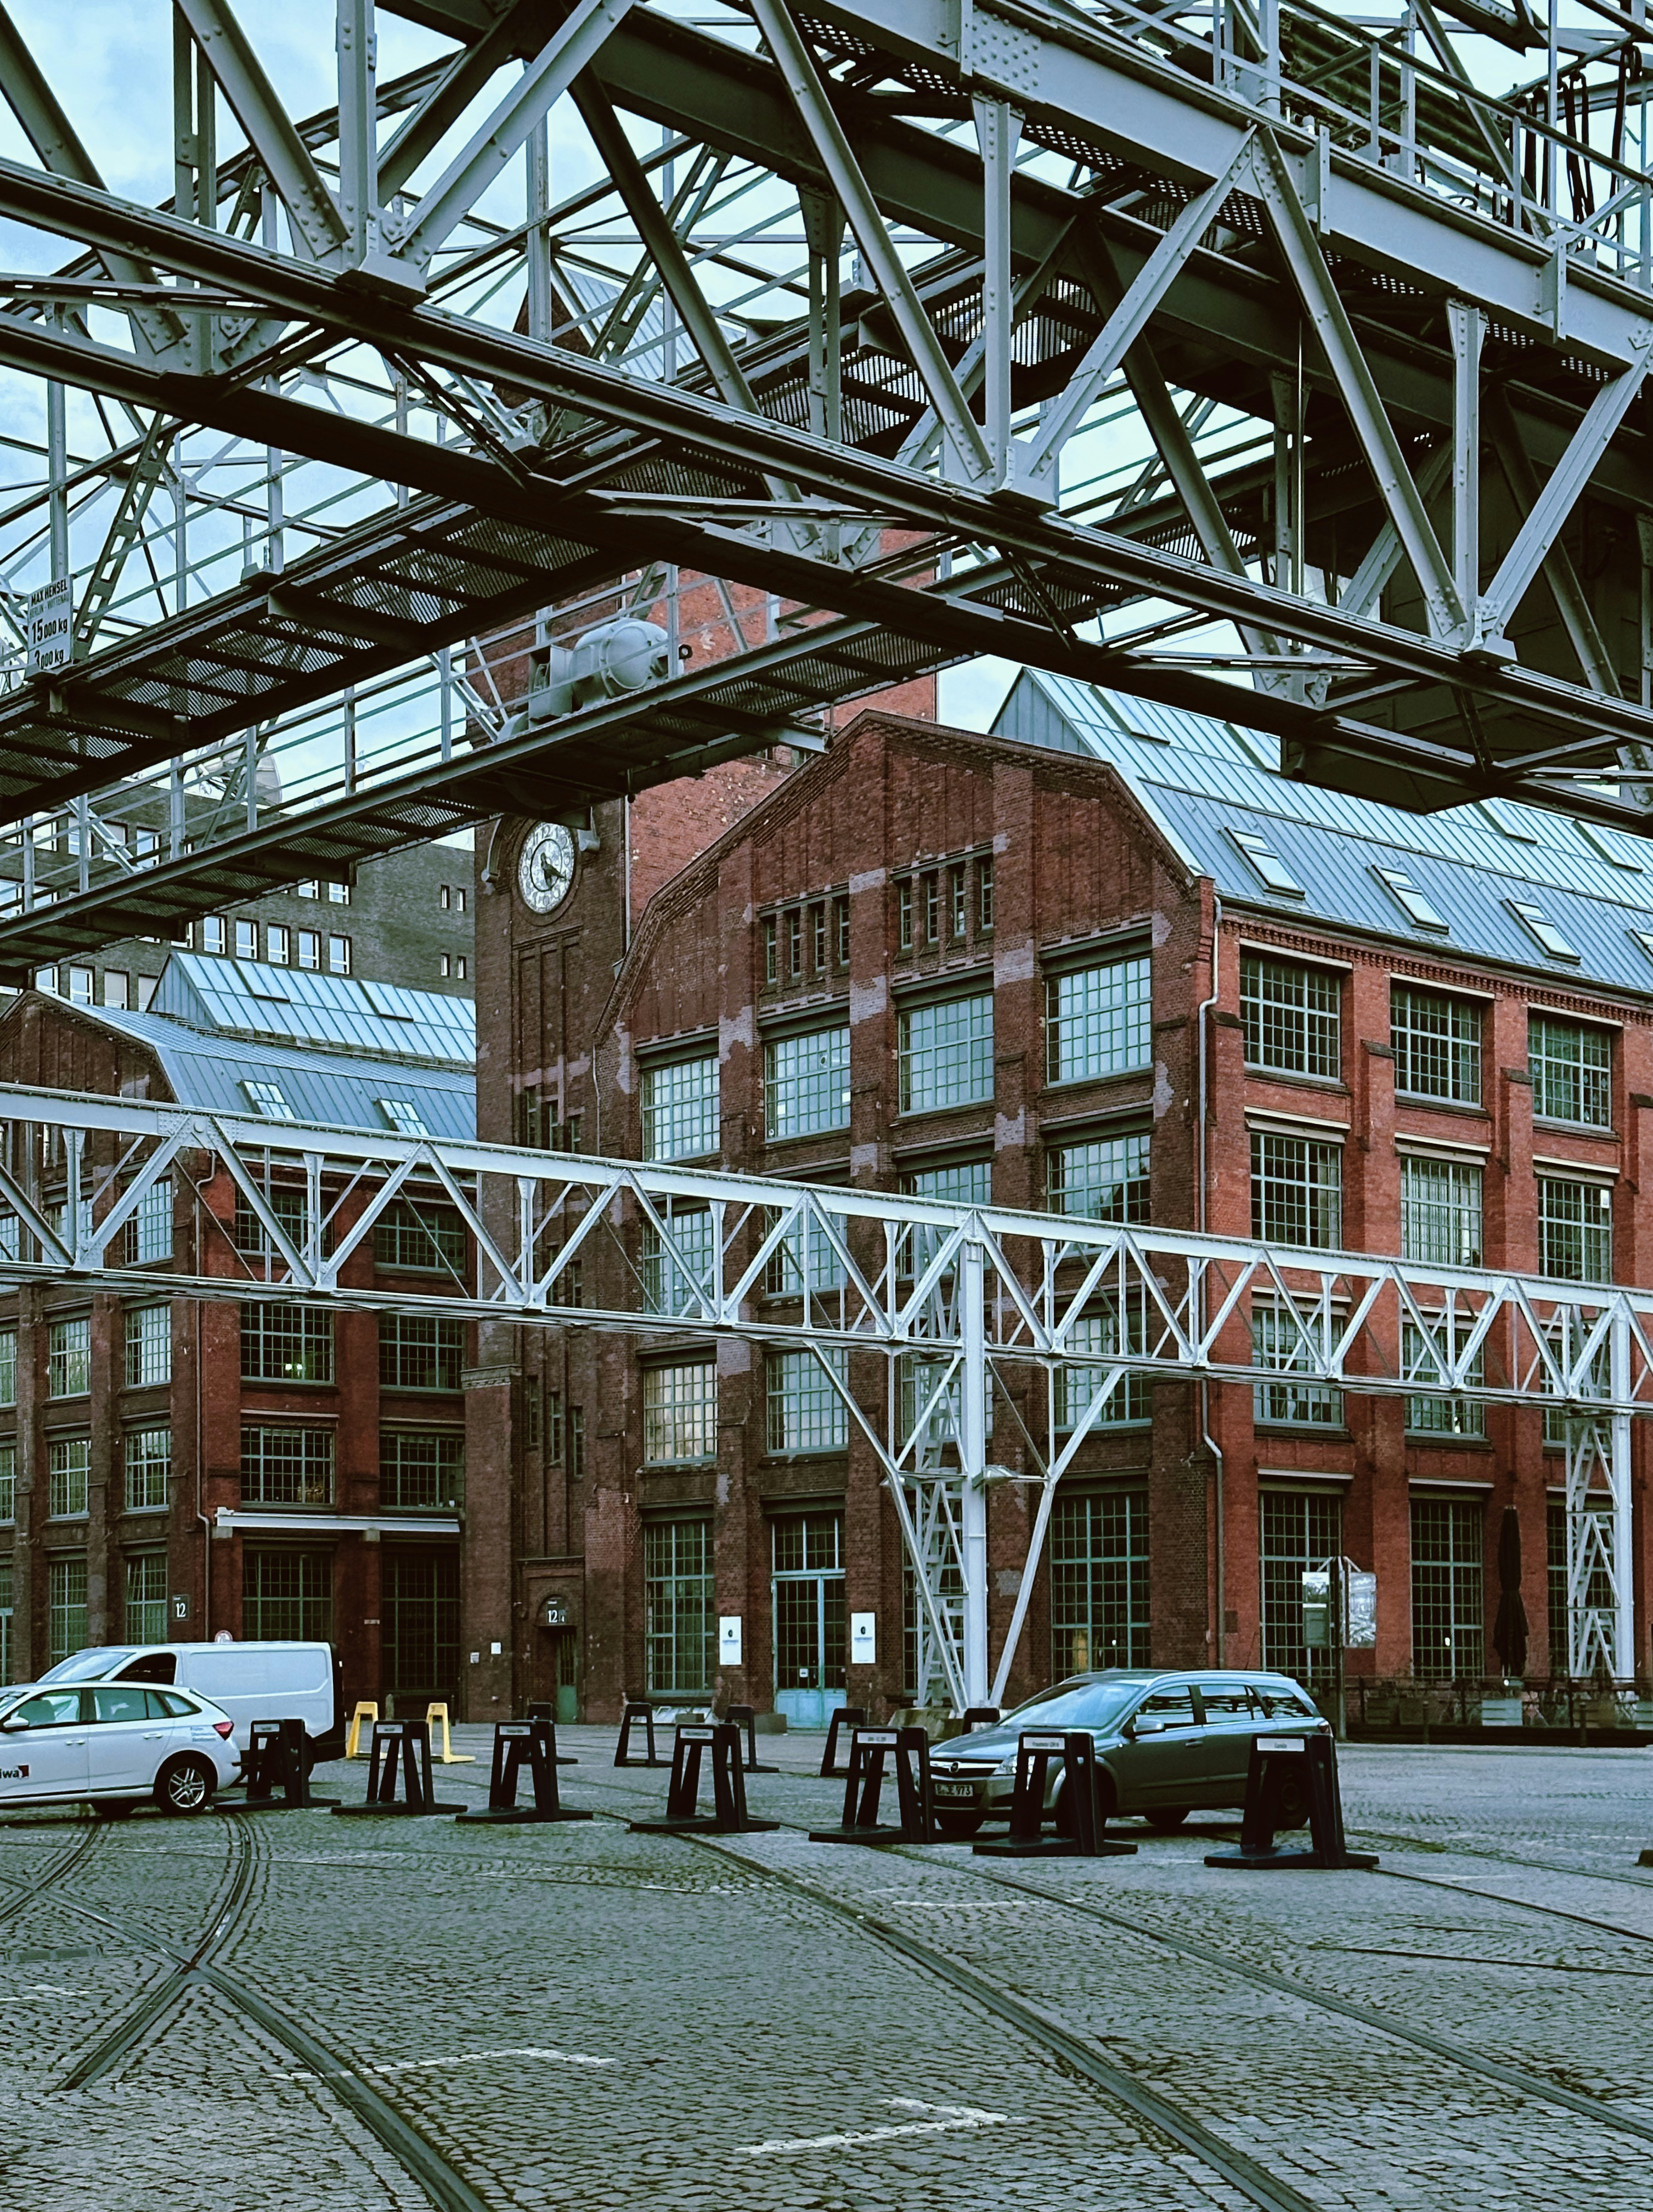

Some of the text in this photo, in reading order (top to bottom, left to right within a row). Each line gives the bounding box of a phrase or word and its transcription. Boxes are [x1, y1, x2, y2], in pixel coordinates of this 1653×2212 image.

[31, 579, 67, 606] MAX HENSEL
[58, 618, 67, 634] kg
[55, 648, 64, 664] kg
[533, 831, 539, 845] 11
[541, 825, 551, 839] 12
[560, 836, 568, 850] 2
[176, 1602, 187, 1617] 12
[548, 1610, 558, 1623] 12
